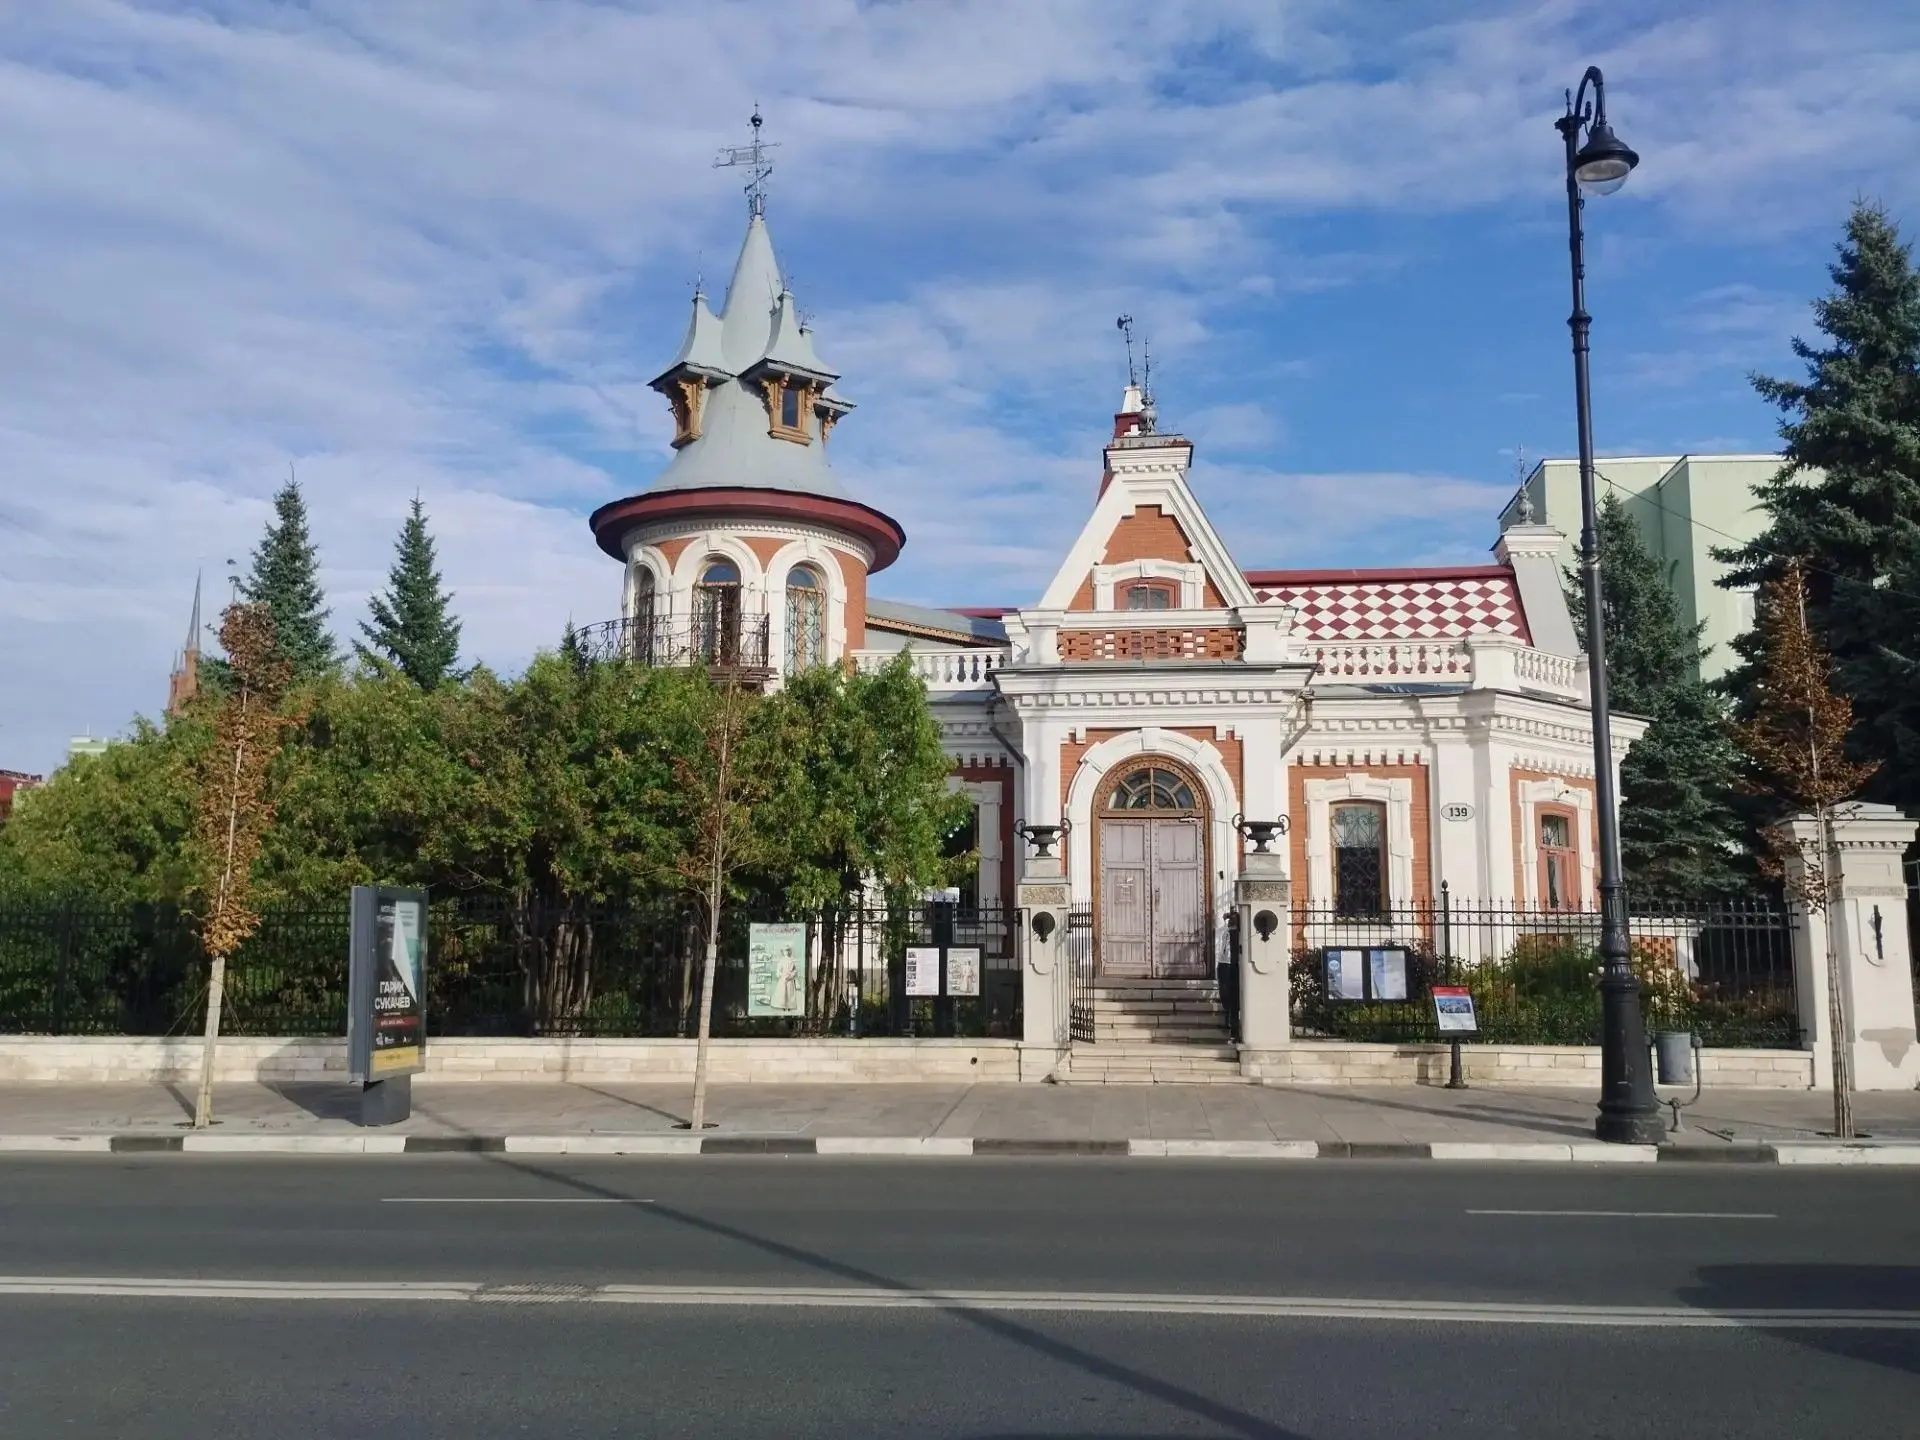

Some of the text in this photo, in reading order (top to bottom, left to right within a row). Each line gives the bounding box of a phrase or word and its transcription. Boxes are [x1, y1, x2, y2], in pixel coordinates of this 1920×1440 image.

[1449, 807, 1468, 817] 139
[380, 981, 404, 994] ГАРИК
[375, 993, 410, 1010] СУКАЧЁВ
